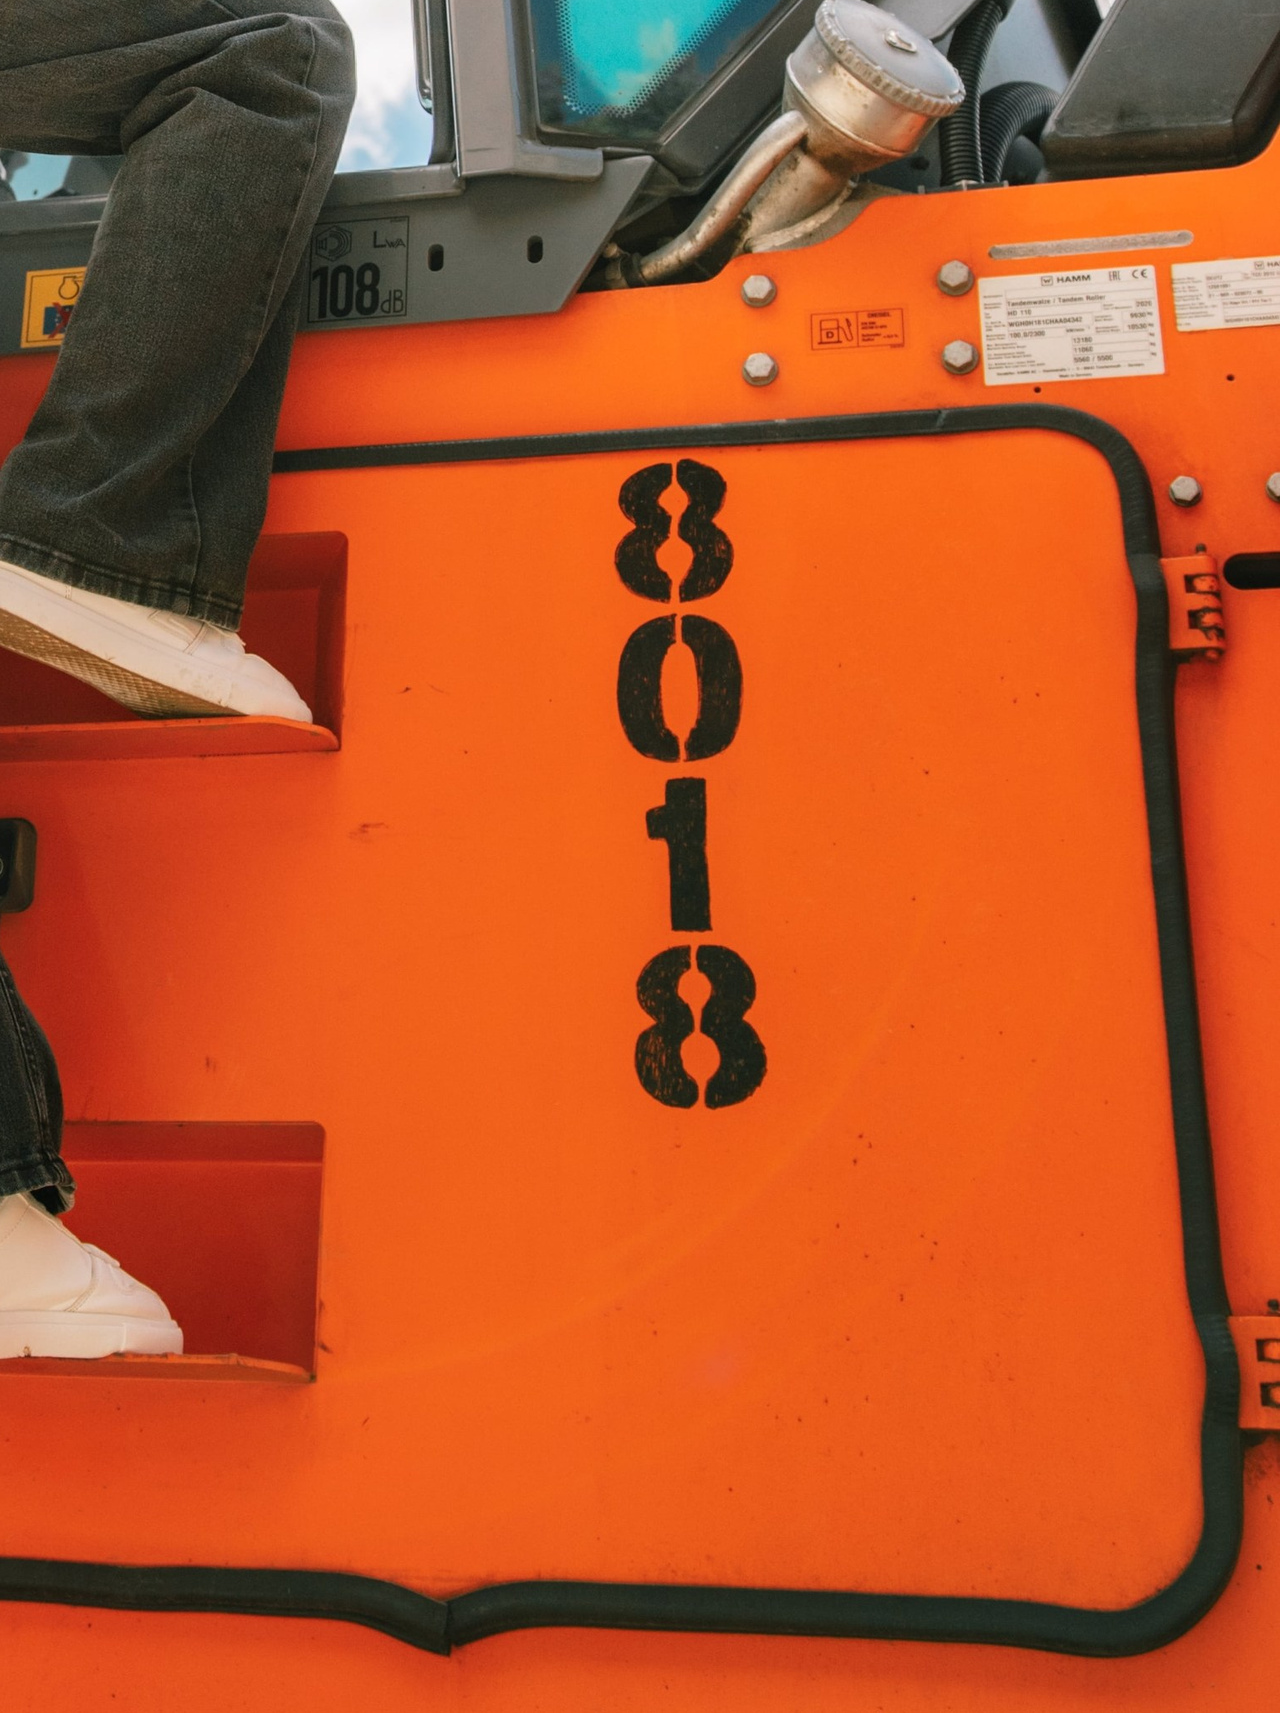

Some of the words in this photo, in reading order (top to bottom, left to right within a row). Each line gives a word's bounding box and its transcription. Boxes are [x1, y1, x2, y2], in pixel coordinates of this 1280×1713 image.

[1057, 274, 1091, 284] HAMM
[312, 262, 381, 319] 108
[381, 289, 404, 314] dB
[1008, 297, 1051, 307] Tandemwalze
[1058, 296, 1084, 304] Tandem
[825, 331, 834, 339] D
[615, 458, 768, 1110] 8018
